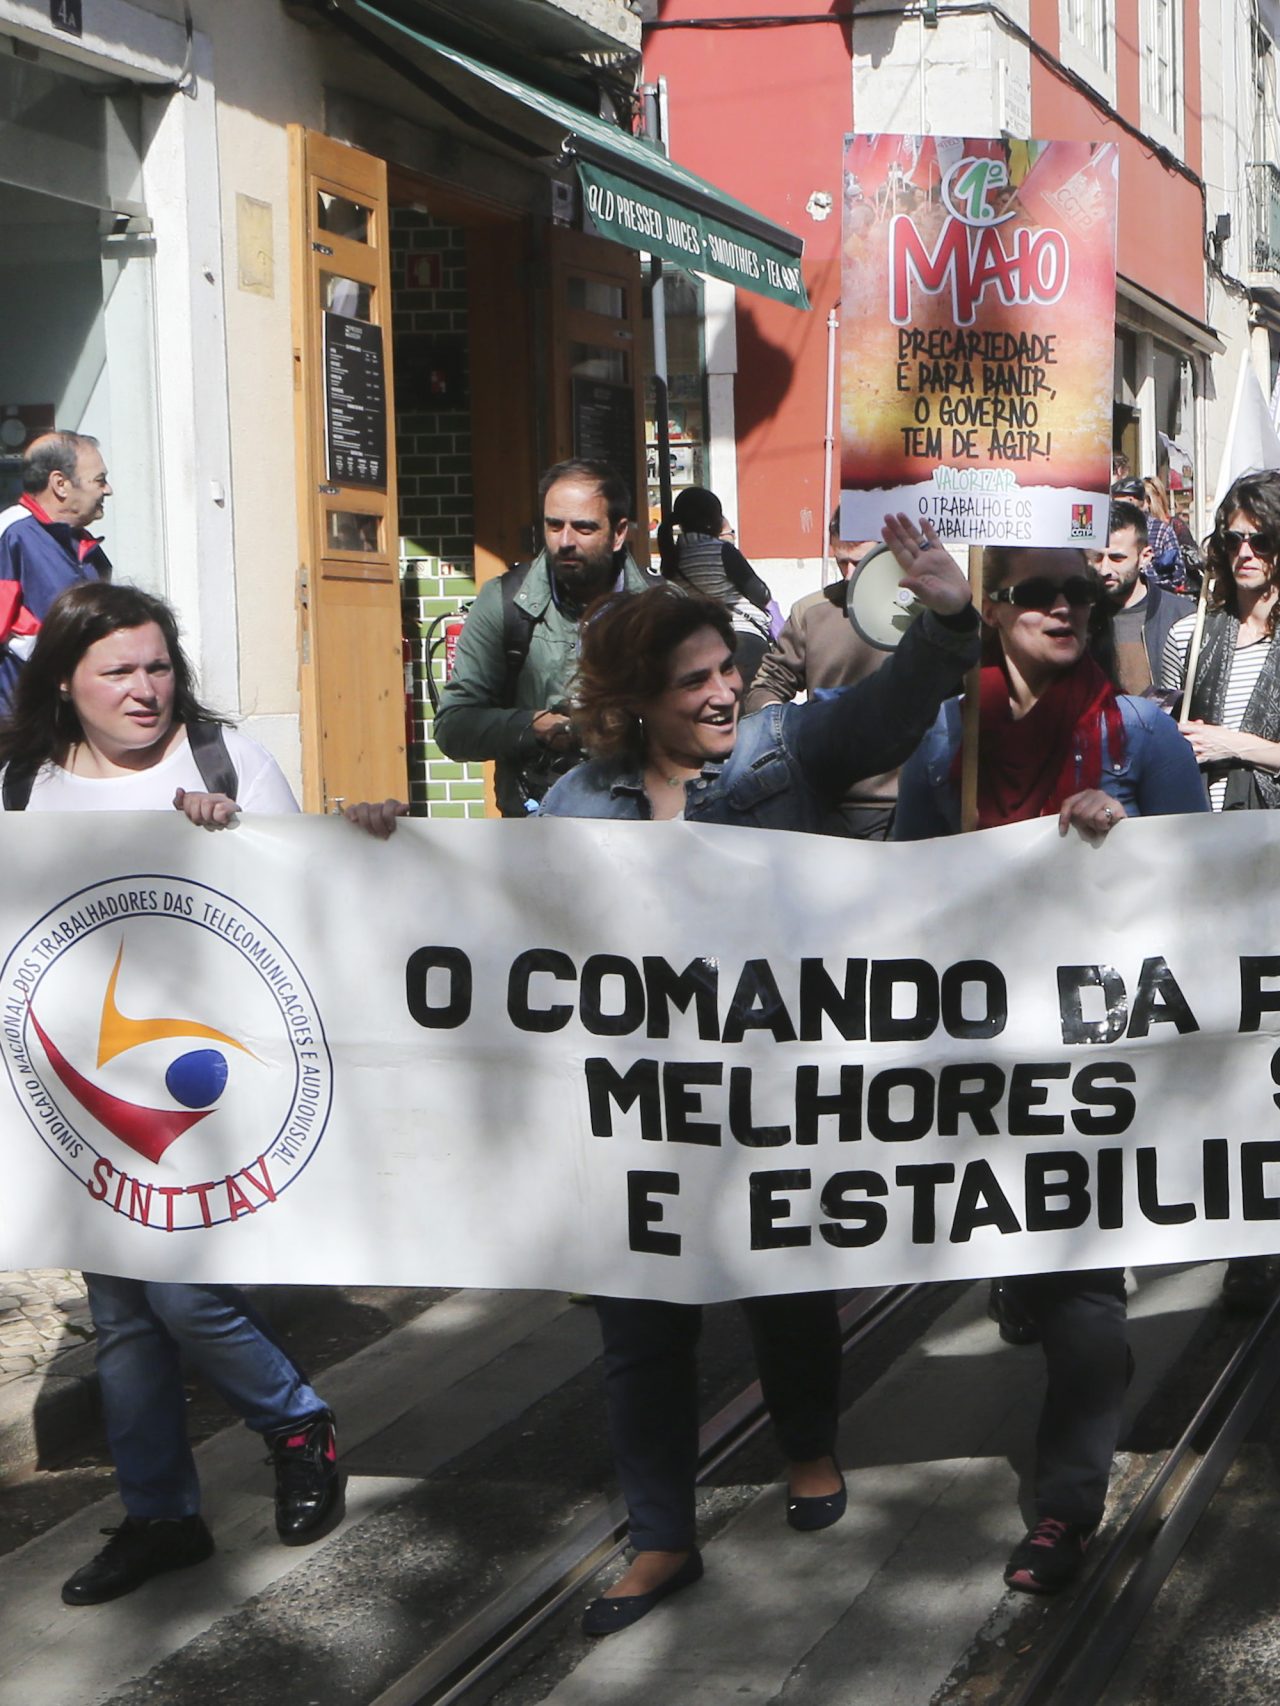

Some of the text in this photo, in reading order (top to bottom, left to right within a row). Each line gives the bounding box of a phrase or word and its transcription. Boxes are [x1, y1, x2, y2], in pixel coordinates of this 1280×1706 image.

[616, 194, 662, 240] PRESSED
[666, 216, 700, 255] JUICES
[708, 233, 760, 279] SMOOTHIES
[766, 258, 783, 289] TEA
[890, 214, 1069, 325] MAIO
[898, 327, 1058, 365] PRECARIEDADE
[918, 360, 974, 394] PARA
[983, 362, 1057, 400] BANIR,
[901, 427, 1052, 461] TEM DE AGIR!
[914, 395, 1038, 428] O GOVERNO
[918, 496, 1033, 518] O TRABALHO E OS
[935, 467, 1016, 491] VALORIZAR
[4, 890, 321, 1166] SINDICATO NACIONAL DOS TRABALHADORES DAS TELECOMUNICAÇÕES E AUDIOVISUAL
[405, 946, 472, 1029] O
[507, 948, 1007, 1043] COMANDO
[1057, 956, 1201, 1045] DA
[584, 1057, 1137, 1147] MELHORES
[87, 1155, 277, 1232] SINTTAV
[627, 1169, 682, 1256] E
